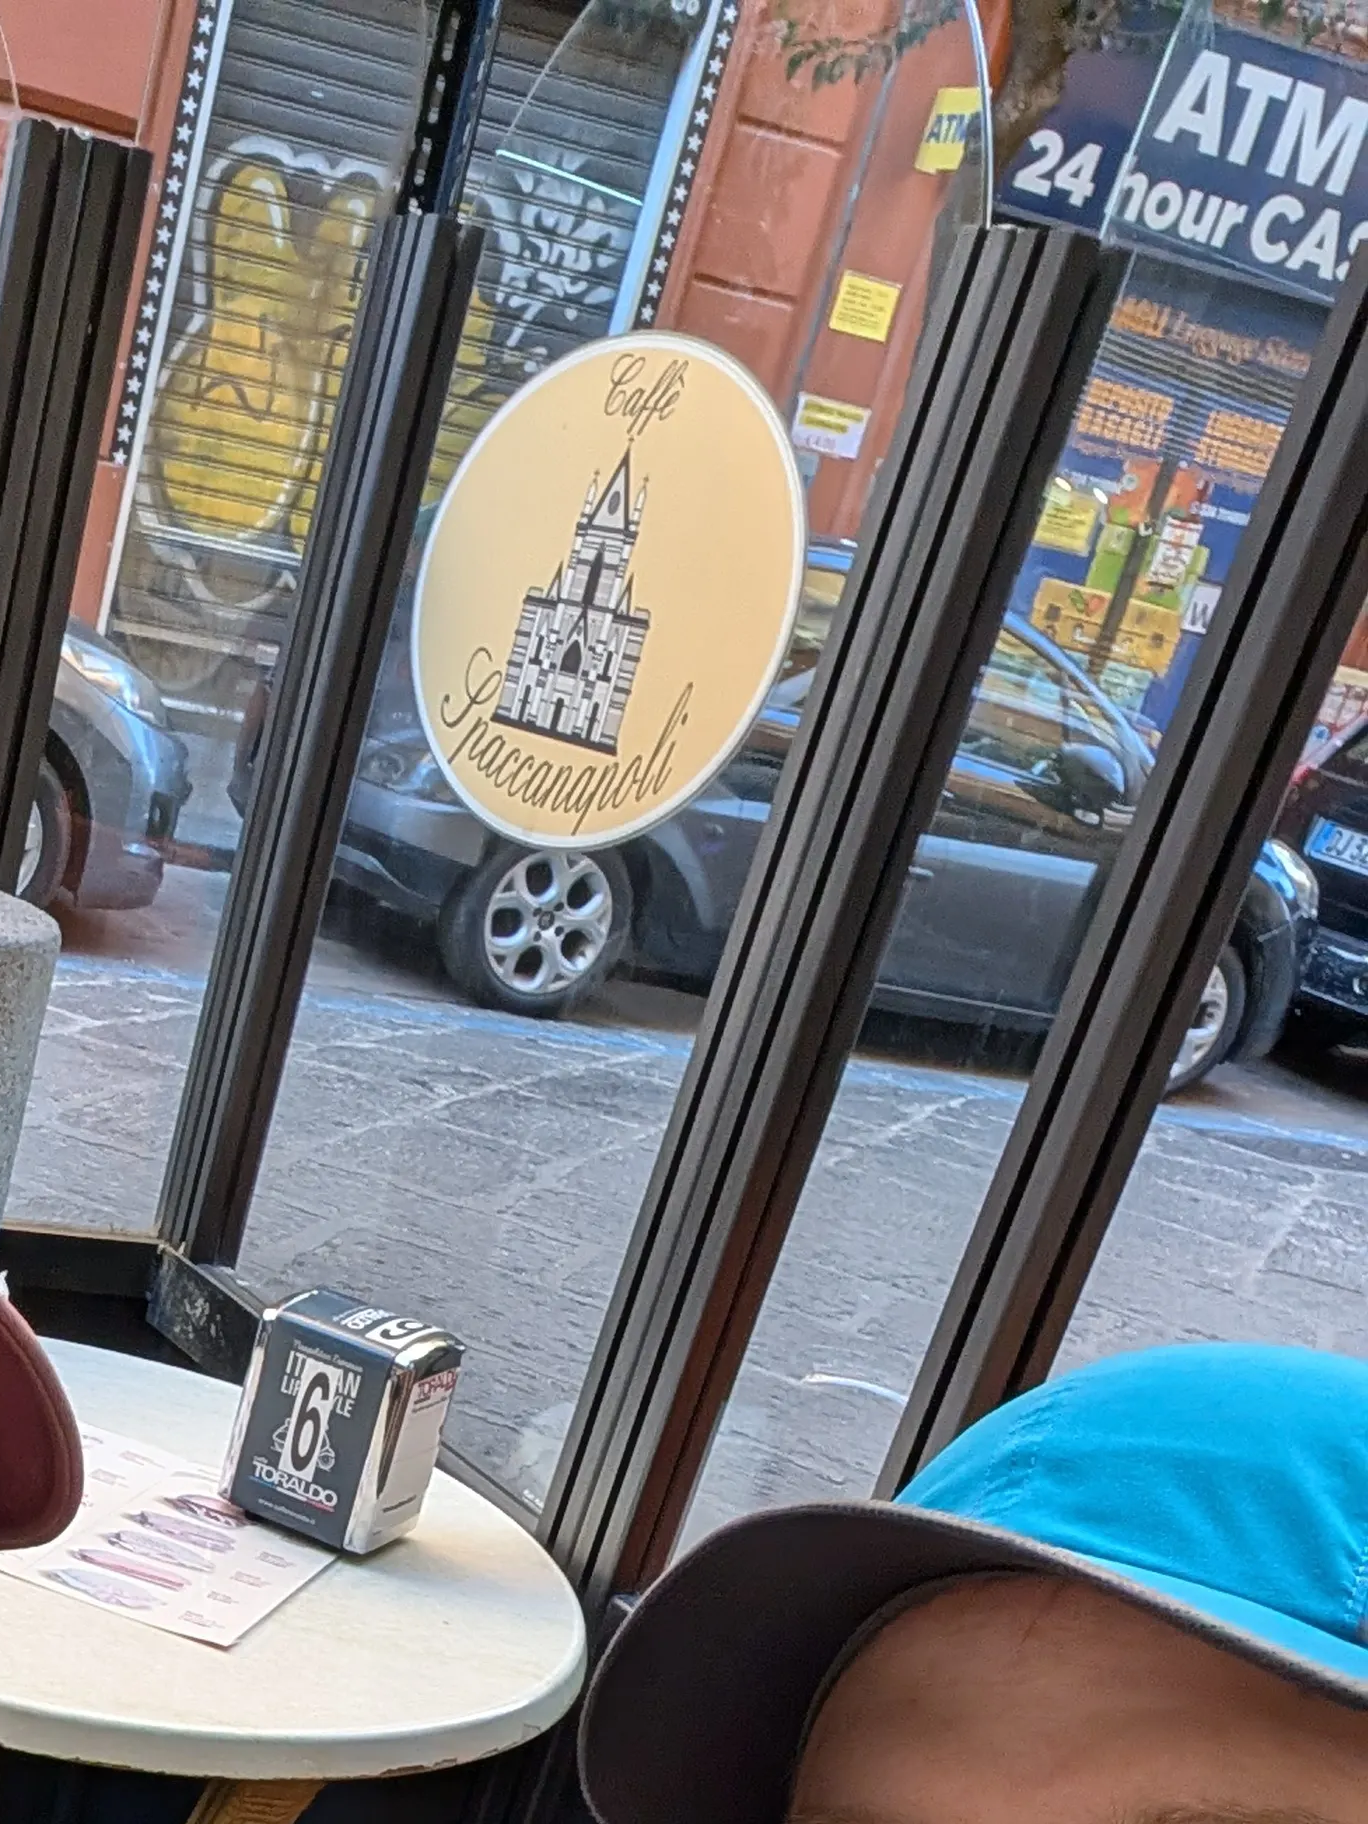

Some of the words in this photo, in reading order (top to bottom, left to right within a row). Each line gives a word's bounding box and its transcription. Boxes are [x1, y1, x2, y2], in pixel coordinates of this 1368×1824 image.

[1153, 49, 1368, 197] ATM
[1013, 130, 1103, 208] 24
[1107, 153, 1249, 249] hour
[604, 353, 689, 436] Caffè
[440, 647, 695, 836] Spaccanapoli
[290, 1371, 330, 1472] 6
[252, 1461, 338, 1507] TORALDO
